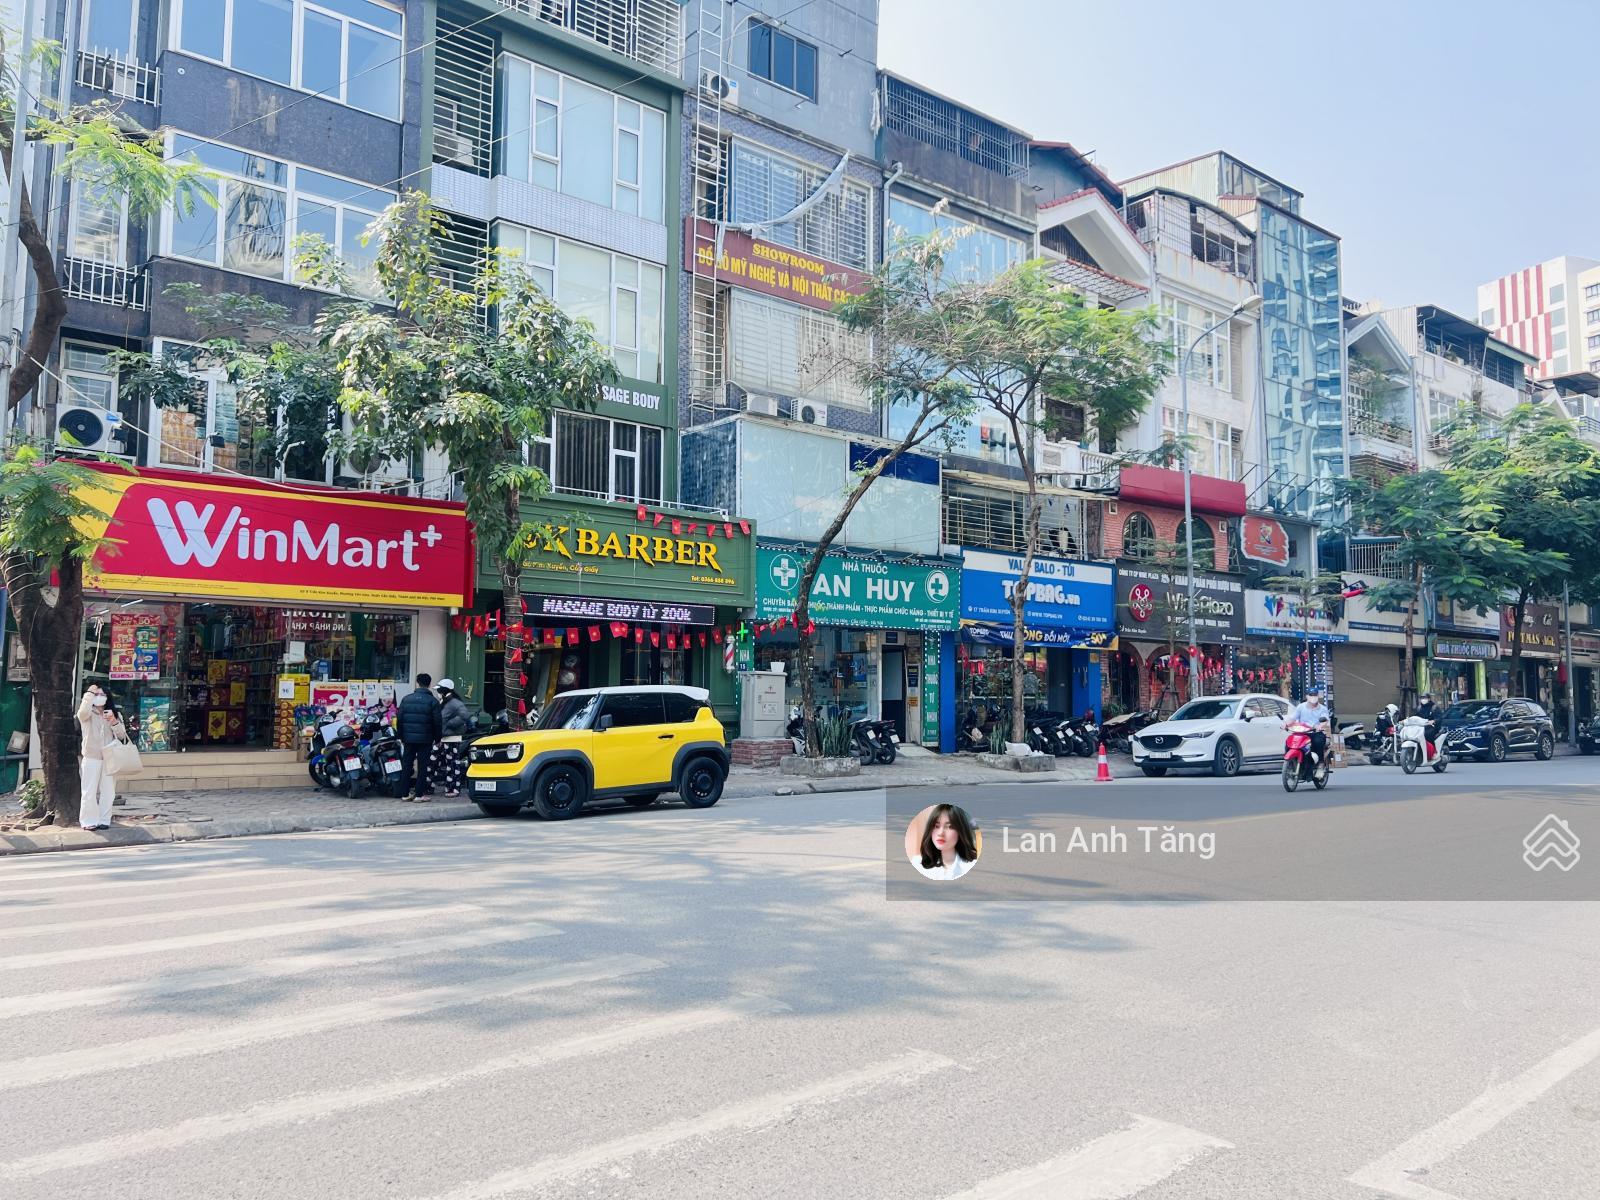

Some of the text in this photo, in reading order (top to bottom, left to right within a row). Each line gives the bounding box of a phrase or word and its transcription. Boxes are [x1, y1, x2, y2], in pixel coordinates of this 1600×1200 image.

[752, 243, 824, 275] SHOWROOM
[633, 391, 661, 410] BODY
[575, 527, 723, 573] BARBER
[842, 561, 888, 574] NHÀ THUỐC
[1008, 558, 1075, 577] VAL BALO TÚI
[812, 573, 915, 602] AN HUY
[607, 603, 640, 618] BODY
[763, 597, 786, 606] CHUYÊN
